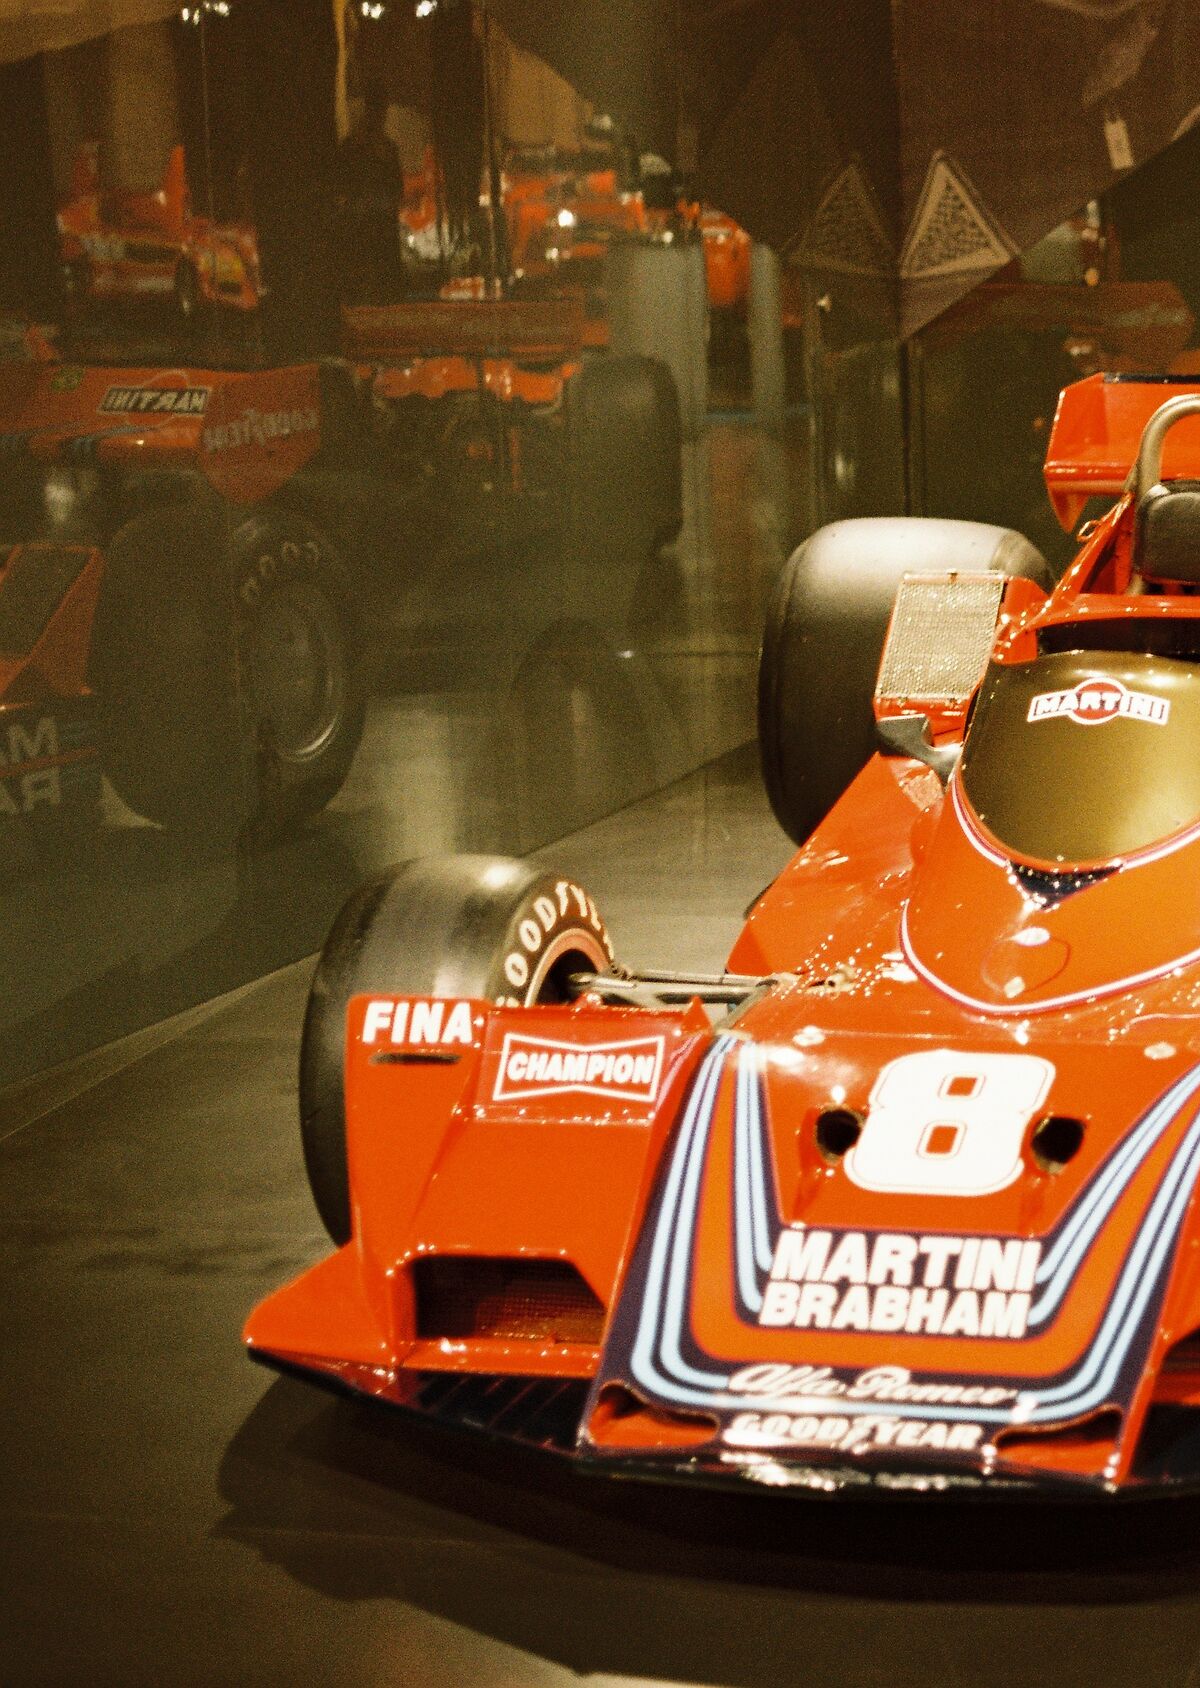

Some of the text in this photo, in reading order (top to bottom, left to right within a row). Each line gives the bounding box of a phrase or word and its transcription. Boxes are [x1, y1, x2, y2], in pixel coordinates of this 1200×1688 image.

[1034, 690, 1165, 720] MARTINI
[362, 1001, 474, 1044] FINA
[506, 1052, 655, 1085] CHAMPION
[843, 1048, 1057, 1198] 8
[769, 1229, 1042, 1292] MARTINI
[758, 1281, 1032, 1339] BRABHAM
[728, 1363, 1019, 1405] Alfa Romeo
[731, 1413, 983, 1450] GOODYEAR
